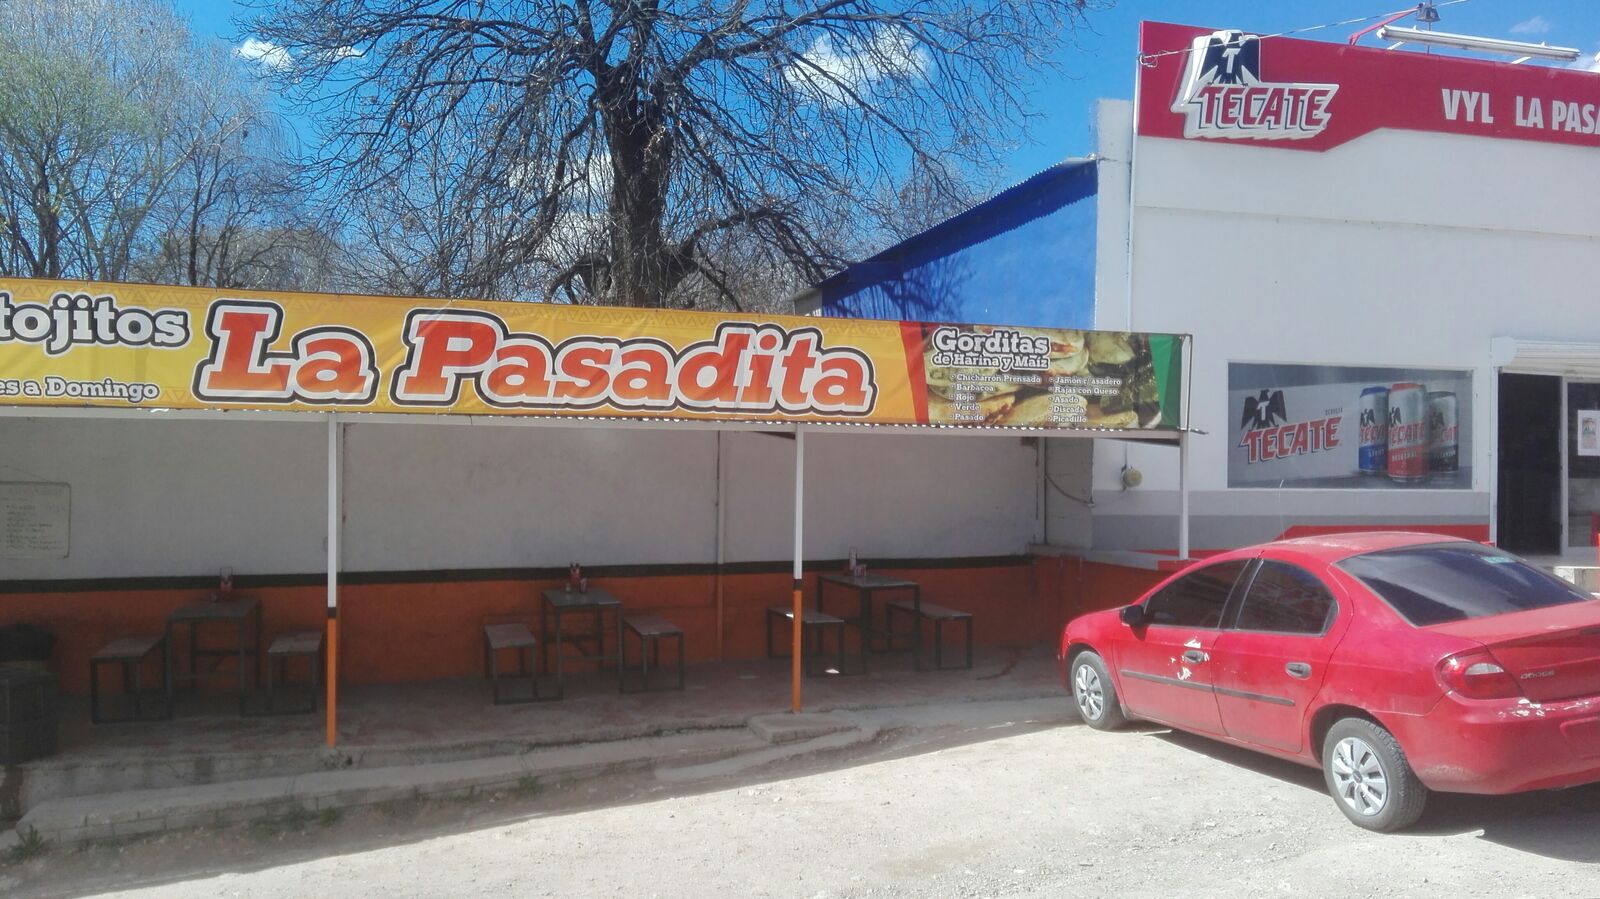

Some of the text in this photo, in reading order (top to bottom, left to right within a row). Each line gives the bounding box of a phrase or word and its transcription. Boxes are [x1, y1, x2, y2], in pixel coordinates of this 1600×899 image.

[1189, 86, 1332, 131] TECATE
[1441, 88, 1494, 124] VYL
[1515, 96, 1544, 129] LA
[932, 328, 1049, 354] Gorditas
[193, 299, 877, 414] La Pasadita
[932, 353, 1049, 370] de Harina y Maíz
[24, 381, 42, 396] a
[45, 377, 160, 402] Domingo
[955, 383, 994, 392] Barbacoa
[955, 393, 975, 402] Rojo
[1093, 387, 1118, 395] Queso
[955, 403, 980, 411] Verde
[1053, 415, 1087, 423] Picadillo
[1239, 416, 1343, 464] TECATE
